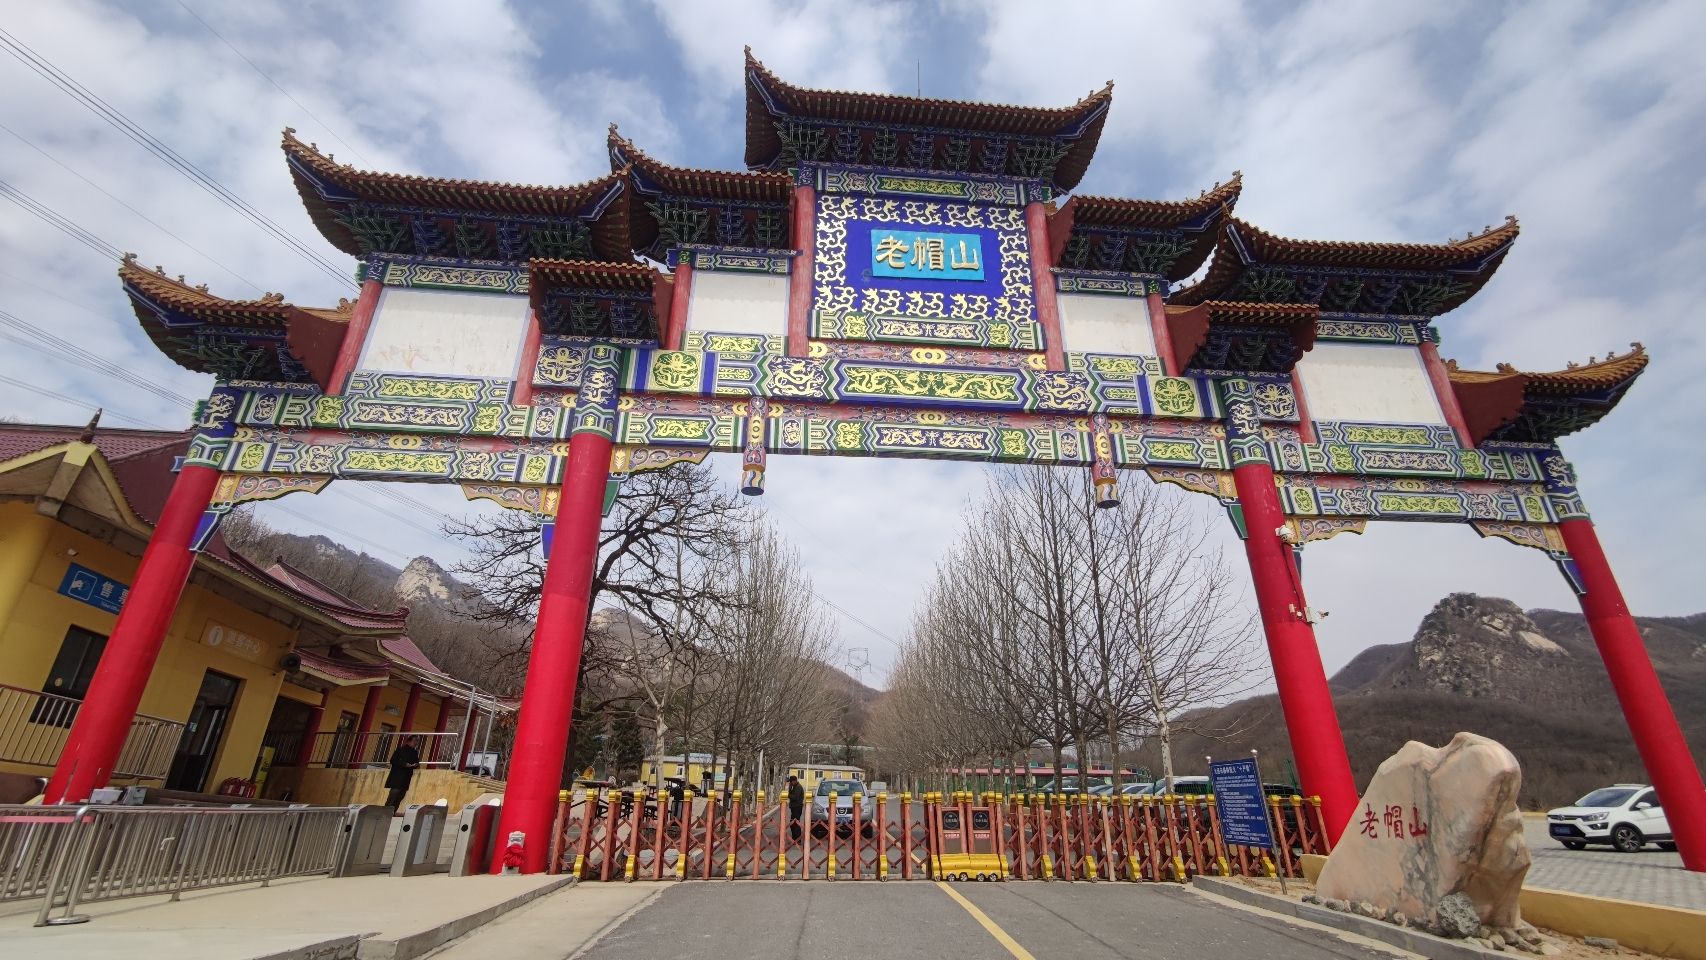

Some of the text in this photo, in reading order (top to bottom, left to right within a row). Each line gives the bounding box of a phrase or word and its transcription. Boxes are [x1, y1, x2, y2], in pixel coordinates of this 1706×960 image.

[875, 234, 980, 271] 老帽山
[1360, 802, 1428, 839] 老帽山
